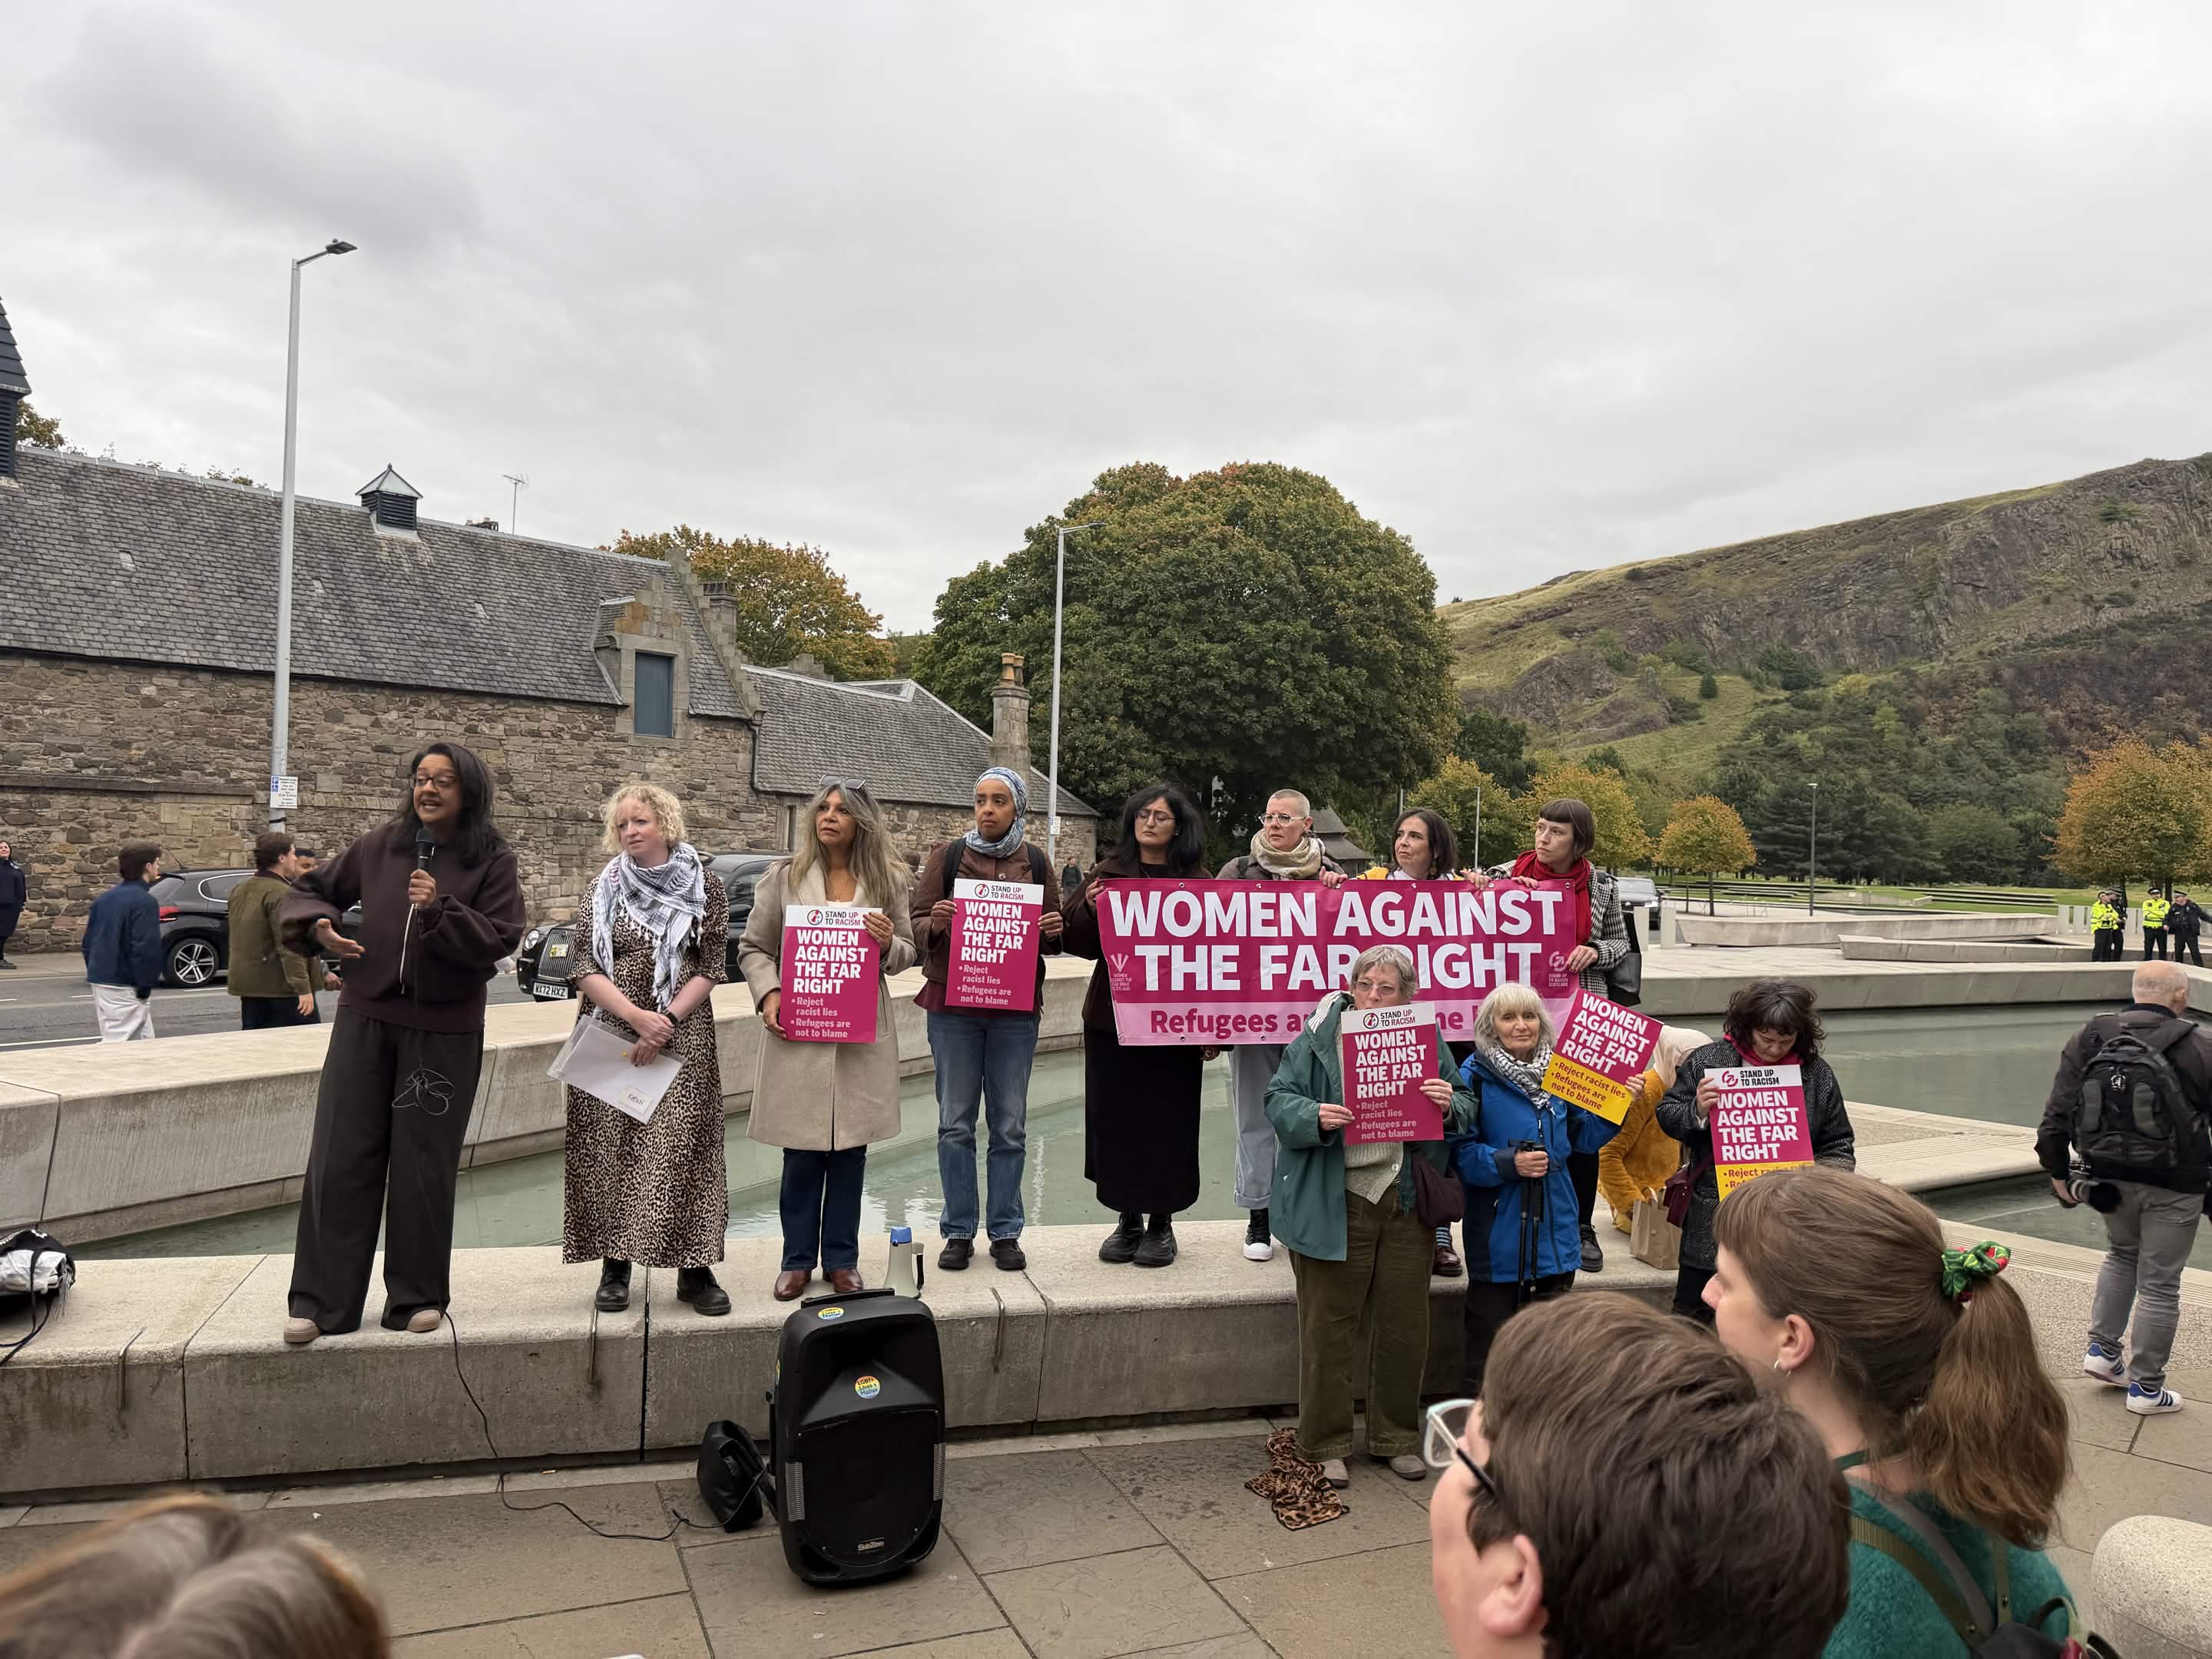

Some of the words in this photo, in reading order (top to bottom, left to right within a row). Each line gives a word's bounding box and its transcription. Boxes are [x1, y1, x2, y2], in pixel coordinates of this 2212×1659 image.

[965, 901, 1022, 919] WOMEN
[1108, 890, 1317, 937] WOMEN
[1333, 890, 1562, 936] AGAINST
[963, 916, 1030, 935] AGAINST
[796, 929, 859, 945] WOMEN
[962, 932, 992, 947] THE
[995, 934, 1023, 949] FAR
[795, 945, 868, 962] AGAINST
[961, 946, 1008, 963] RIGHT
[794, 962, 826, 977] THE
[830, 963, 861, 979] FAR
[964, 965, 988, 975] Reject
[1134, 945, 1241, 991] THE
[1262, 944, 1362, 990] FAR
[1377, 944, 1541, 989] IGHT
[793, 978, 843, 994] RIGHT
[963, 975, 985, 983] racist
[987, 975, 1001, 985] lies
[551, 987, 566, 997] HXZ
[962, 985, 997, 995] Refugees
[796, 997, 823, 1008] Reject
[985, 995, 1008, 1005] blame
[823, 1008, 838, 1016] lies
[1380, 1011, 1401, 1019] STAND
[1582, 993, 1648, 1035] WOMEN
[796, 1018, 834, 1028] Refugees
[1151, 1009, 1278, 1039] Refugees
[1391, 1017, 1416, 1026] RACISM
[822, 1029, 848, 1038] blame
[1355, 1029, 1416, 1050] WOMEN
[1574, 1009, 1650, 1053] AGAINST
[1571, 1023, 1605, 1051] THE
[1604, 1041, 1639, 1068] FAR
[1356, 1045, 1427, 1067] AGAINST
[1561, 1039, 1618, 1074] RIGHT
[1356, 1066, 1388, 1083] THE
[1392, 1063, 1422, 1079] FAR
[1558, 1062, 1584, 1080] Reject
[1585, 1075, 1610, 1091] racist
[1610, 1086, 1627, 1098] lies
[1752, 1077, 1780, 1086] RACISM
[1356, 1080, 1407, 1098] RIGHT
[1555, 1072, 1590, 1094] Refugees
[1591, 1090, 1607, 1101] are
[1551, 1082, 1565, 1092] not
[1576, 1093, 1602, 1110] blame
[1717, 1091, 1788, 1109] WOMEN
[1361, 1100, 1389, 1111] Reject
[1361, 1110, 1386, 1119] racist
[1717, 1108, 1799, 1126] AGAINST
[1361, 1120, 1400, 1130] Refugees
[1361, 1131, 1375, 1140] not
[1718, 1128, 1757, 1144] THE
[1760, 1125, 1799, 1141] FAR
[1721, 1143, 1780, 1161] RIGHT
[1728, 1168, 1758, 1178] Reject
